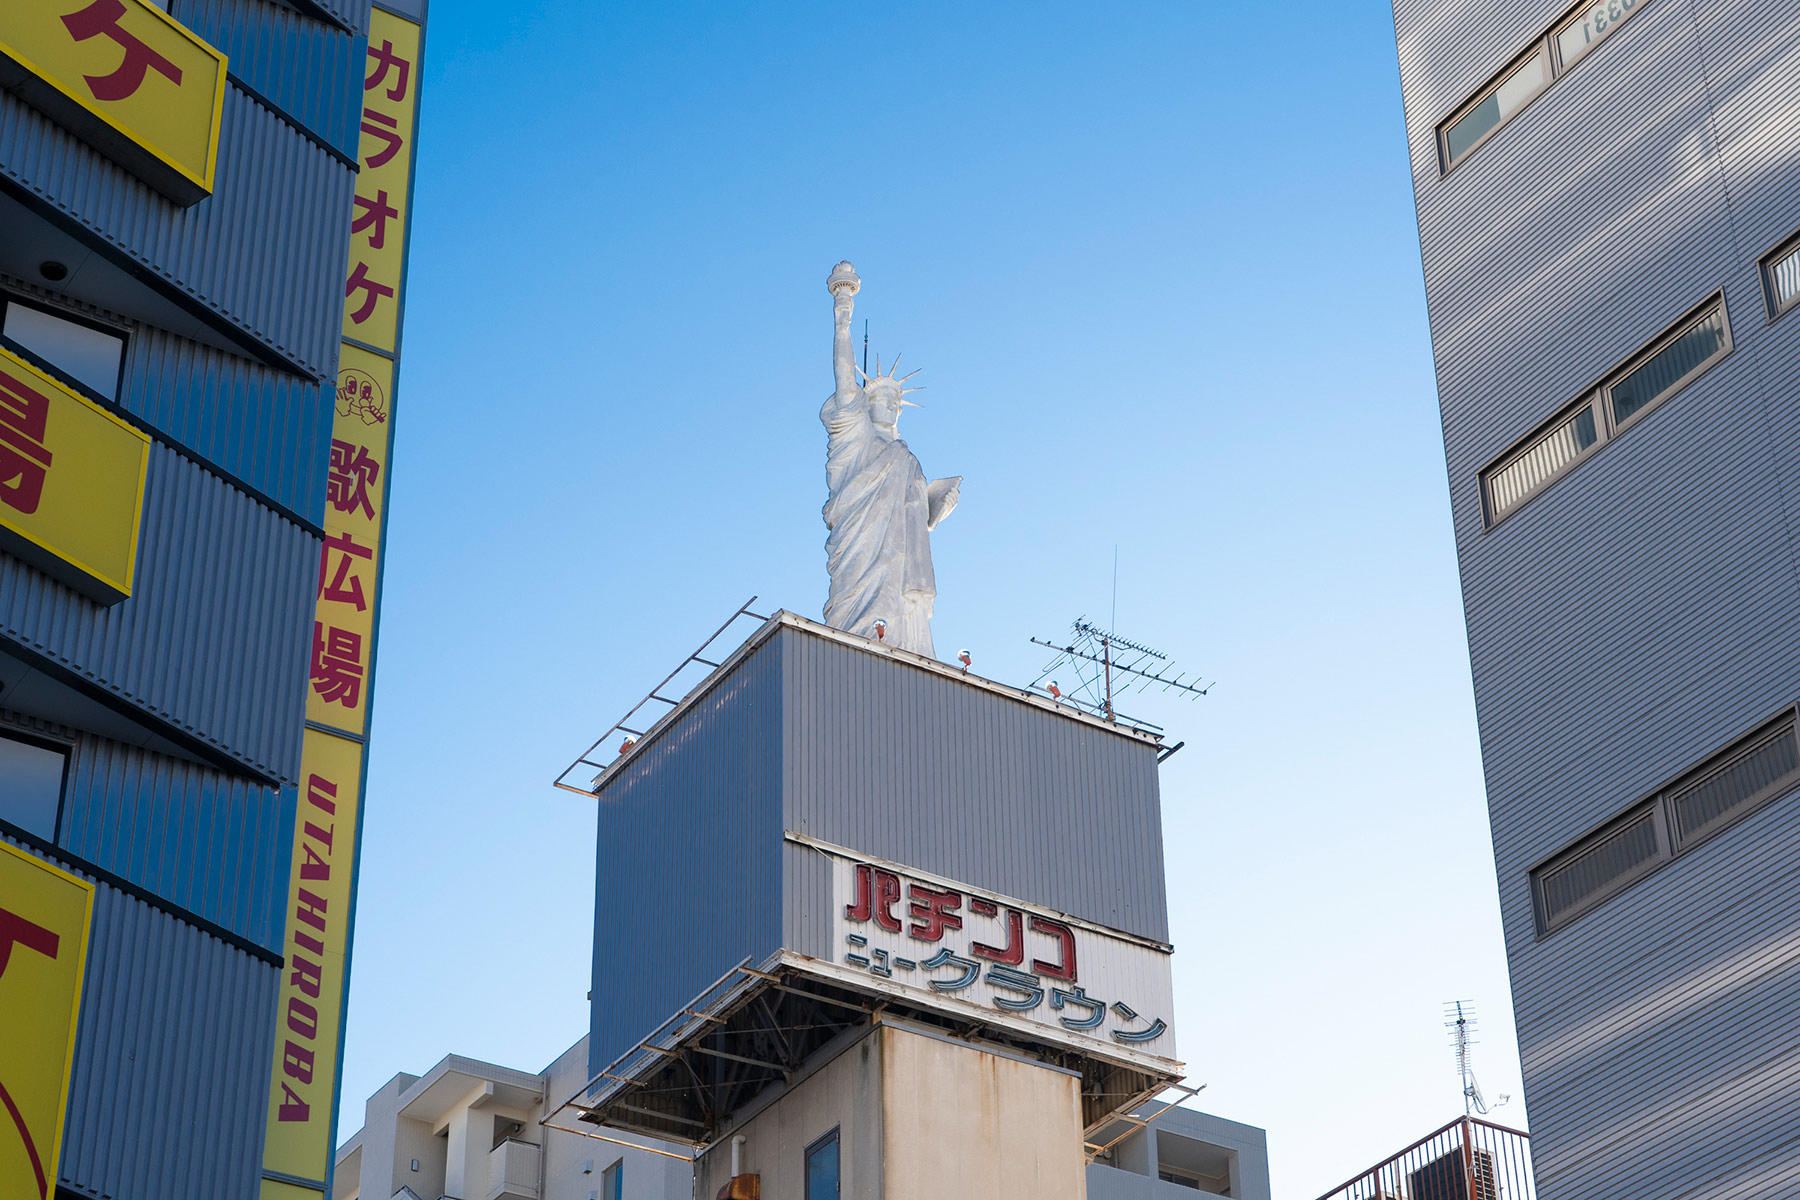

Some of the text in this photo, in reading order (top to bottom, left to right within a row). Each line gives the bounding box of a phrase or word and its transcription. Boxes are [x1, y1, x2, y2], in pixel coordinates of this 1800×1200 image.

[345, 39, 410, 324] カラオケ
[309, 438, 380, 709] 歌広場
[278, 772, 338, 1122] UTAHIROBA
[845, 862, 1078, 983] パチンコ
[846, 934, 1168, 1043] ニュークラウン
